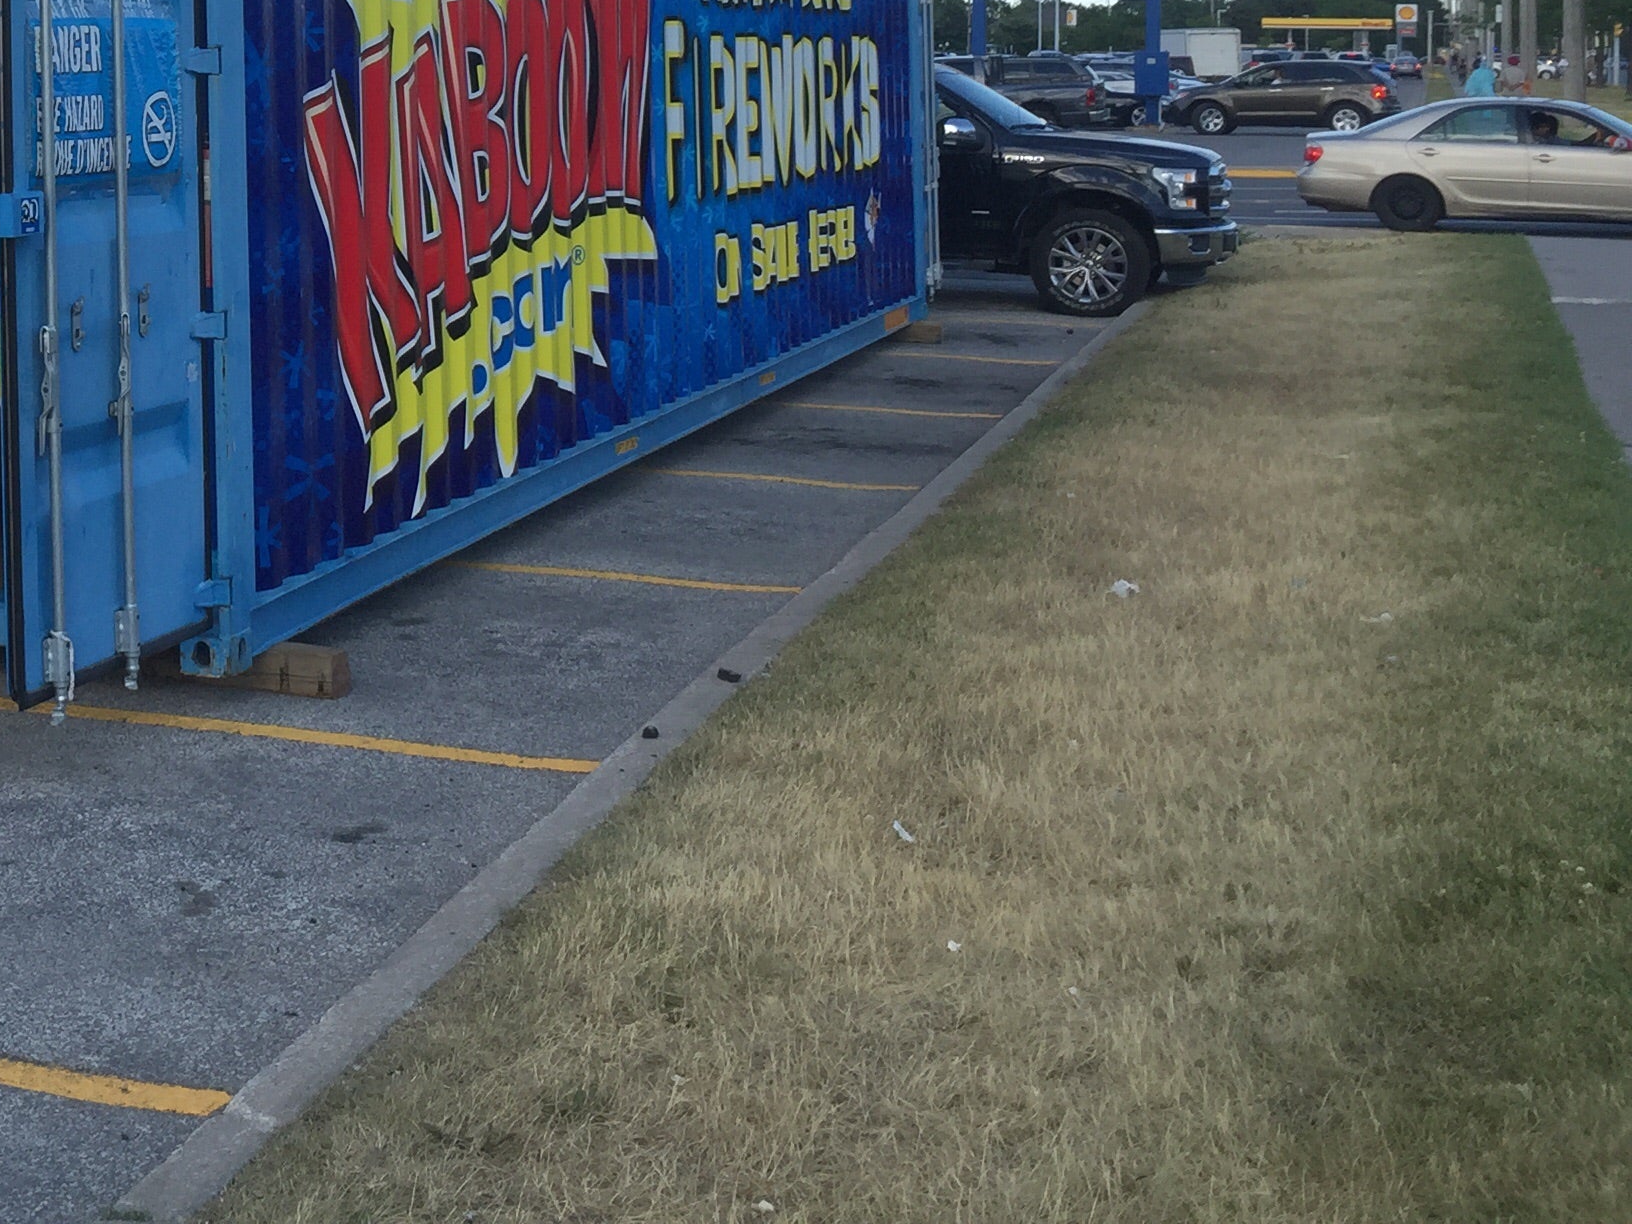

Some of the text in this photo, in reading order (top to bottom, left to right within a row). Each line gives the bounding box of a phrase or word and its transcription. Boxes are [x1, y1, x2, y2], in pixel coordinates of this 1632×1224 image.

[65, 95, 103, 132] HAZARD
[664, 20, 881, 203] FIREWORKS
[715, 232, 742, 303] ON
[751, 222, 800, 291] SALE
